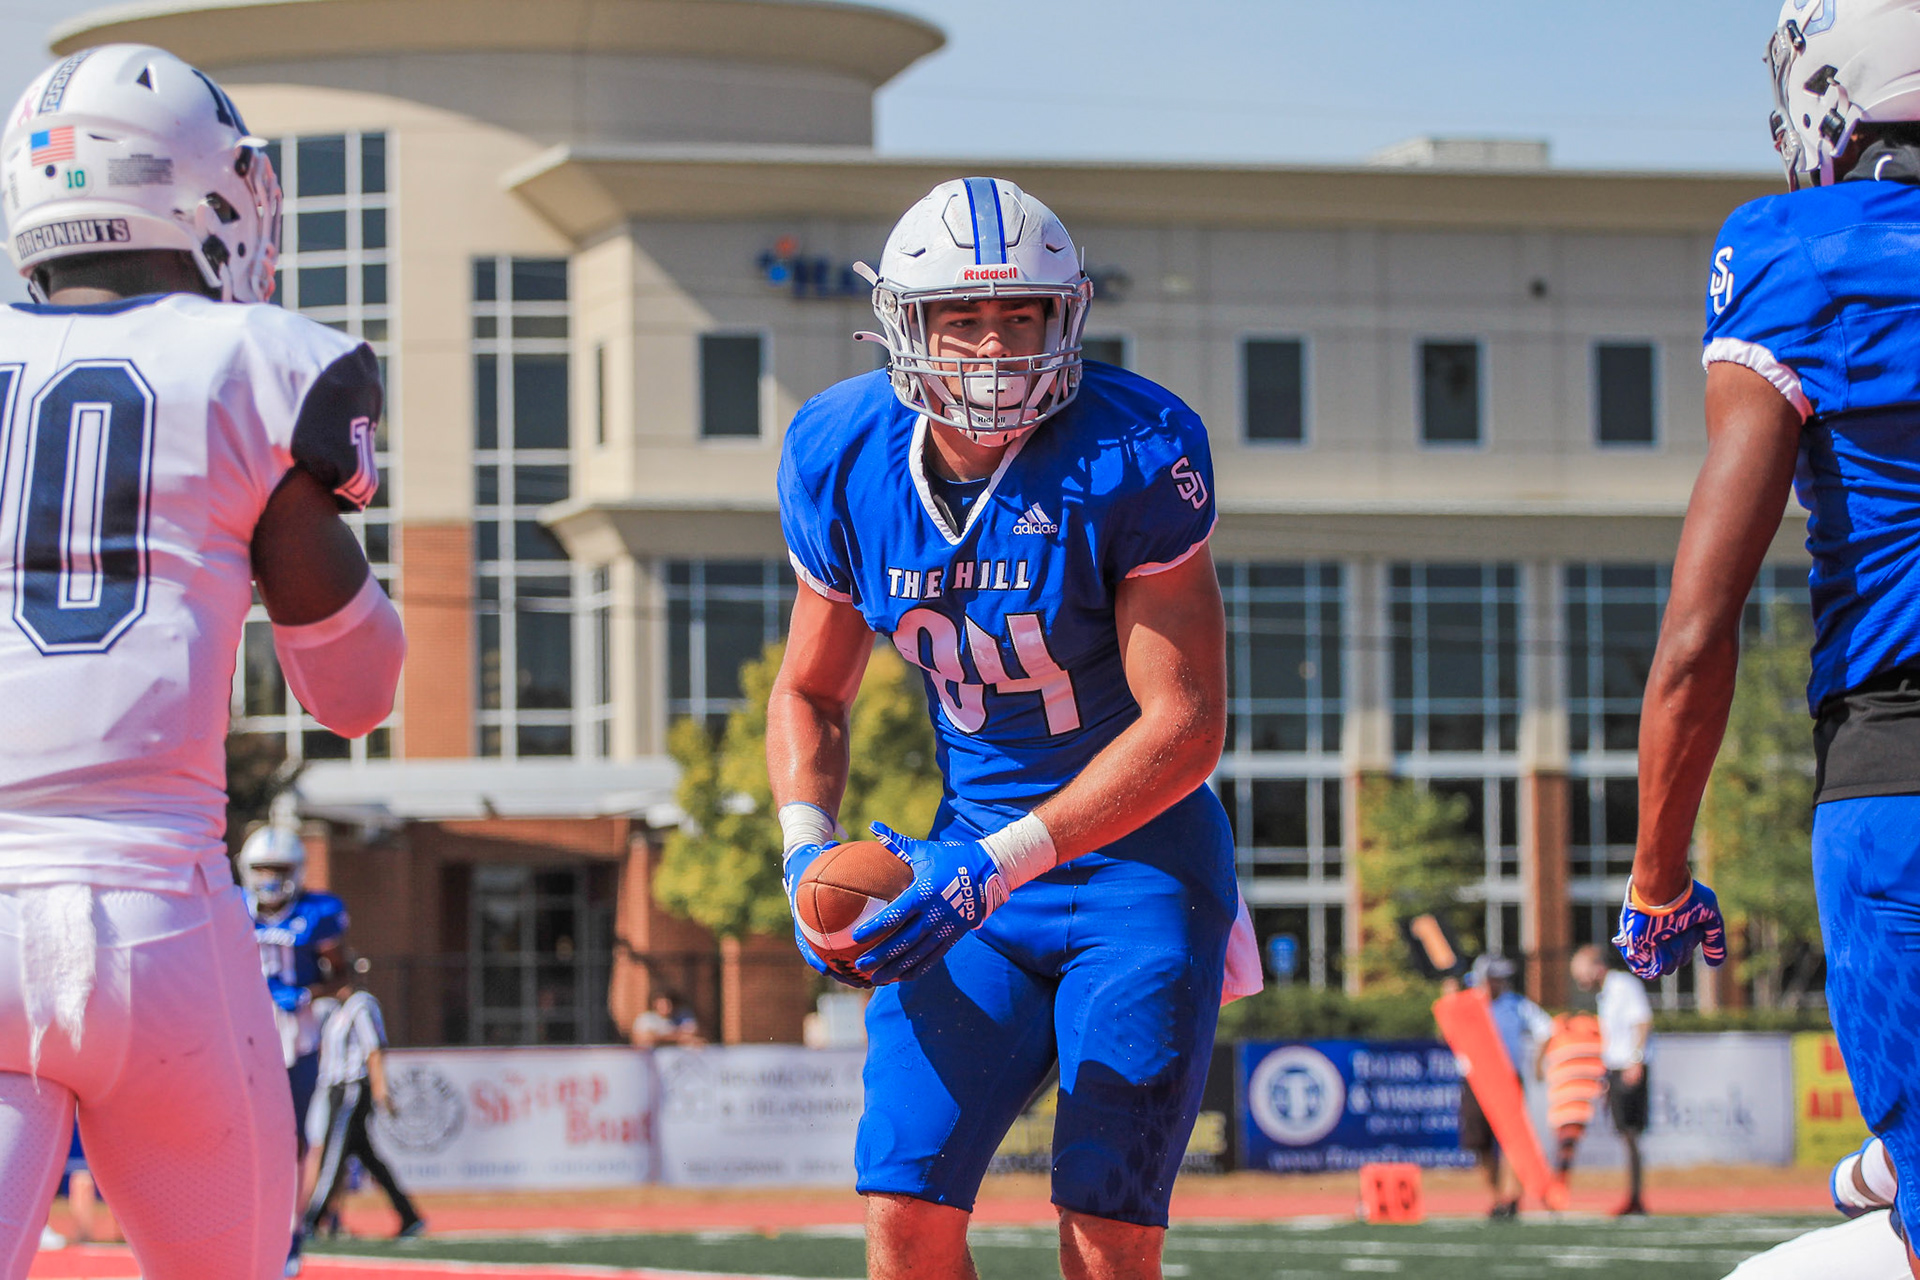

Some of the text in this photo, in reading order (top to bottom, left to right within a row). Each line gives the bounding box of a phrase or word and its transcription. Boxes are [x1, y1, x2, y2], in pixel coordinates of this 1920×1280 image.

[66, 169, 86, 189] 10
[16, 219, 131, 260] ARGONAUTS
[964, 267, 1018, 281] Riddell
[0, 358, 157, 657] 0
[1012, 520, 1058, 535] adidas
[888, 560, 1032, 600] THE HILL
[892, 607, 1083, 737] 84
[957, 866, 976, 921] adidas
